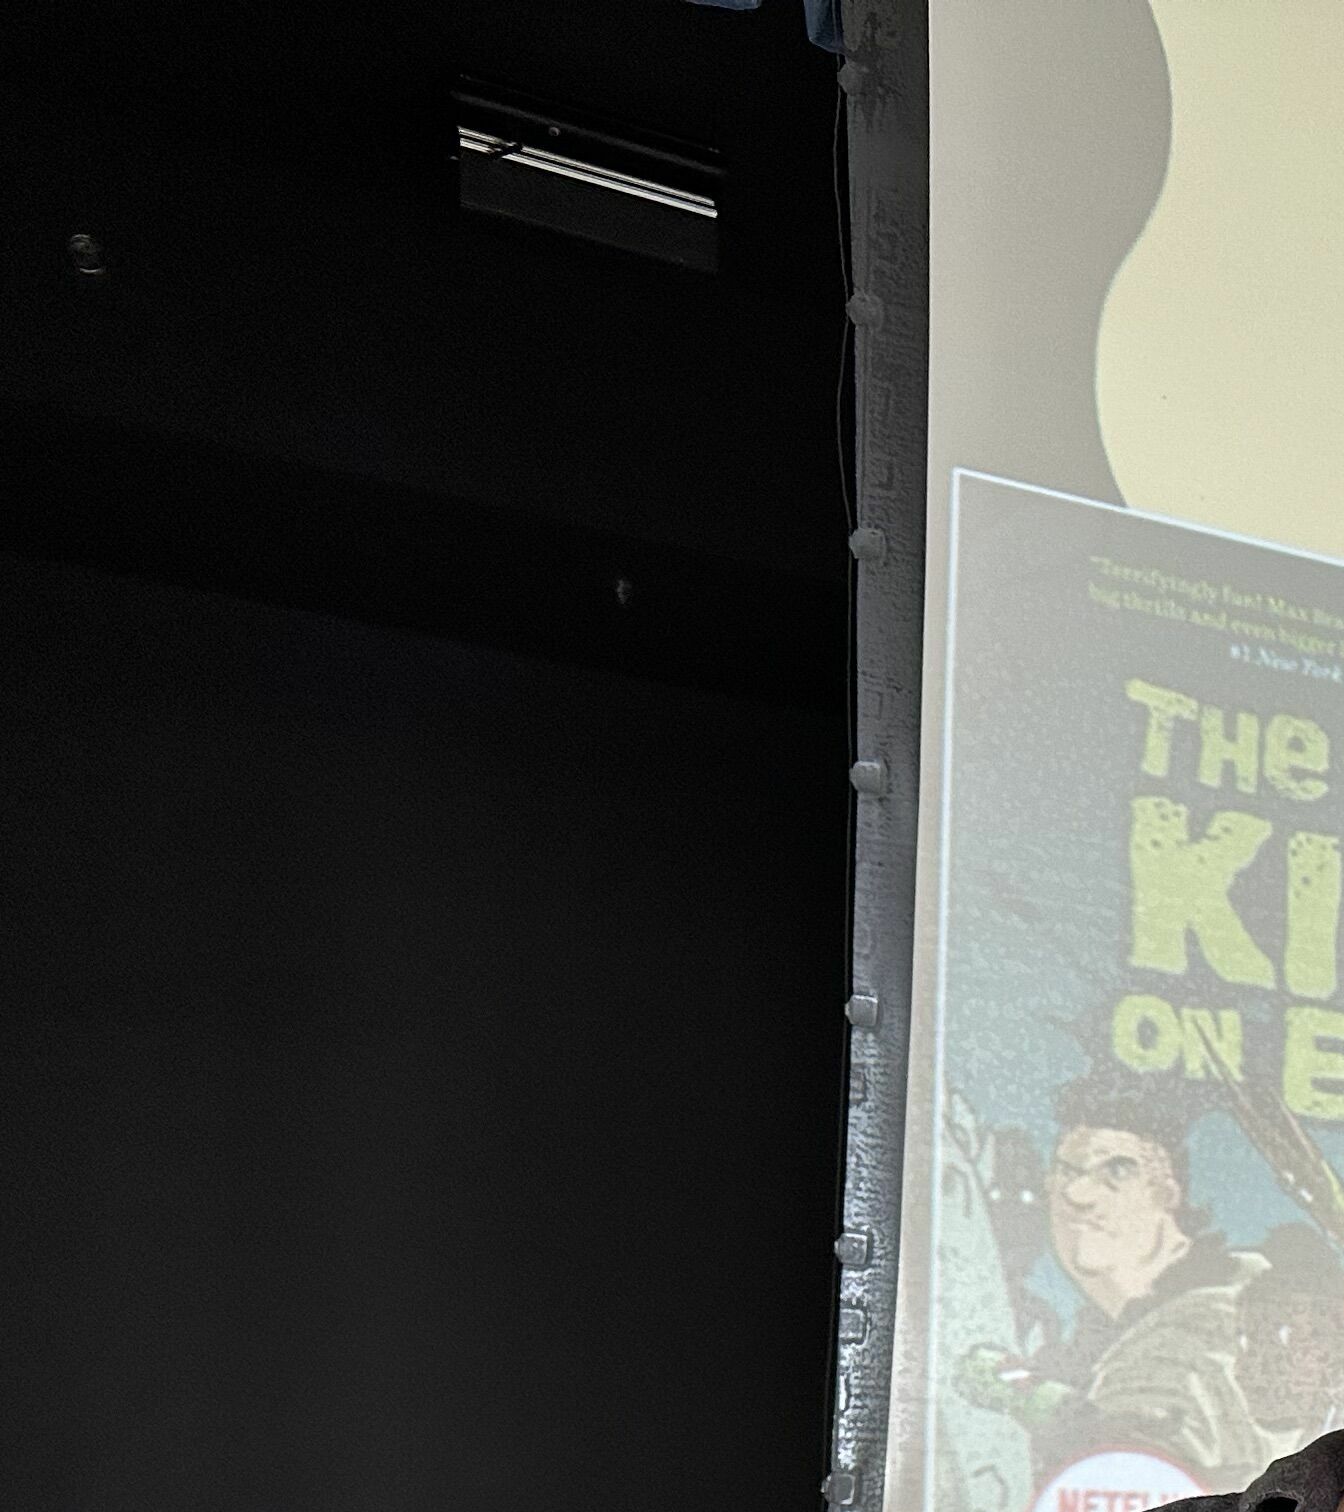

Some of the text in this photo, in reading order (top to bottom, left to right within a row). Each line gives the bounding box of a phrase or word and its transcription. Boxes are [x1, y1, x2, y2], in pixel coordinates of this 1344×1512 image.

[1256, 645, 1299, 672] New
[1300, 656, 1343, 684] York
[1111, 995, 1246, 1082] ON
